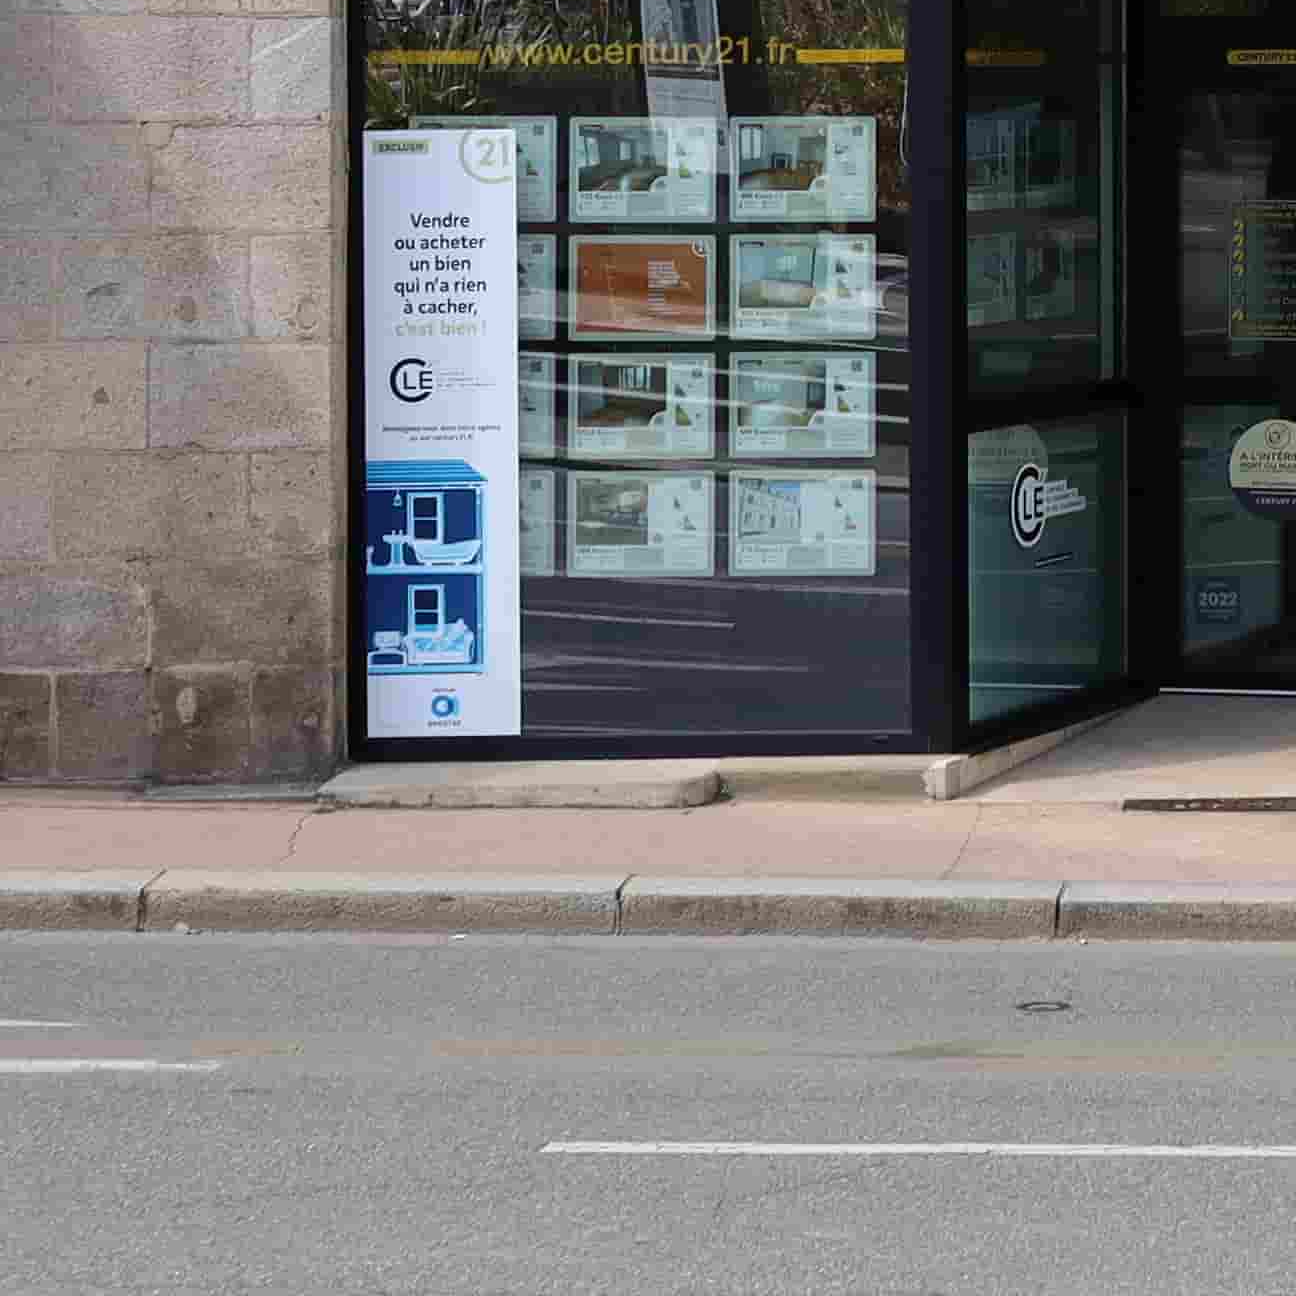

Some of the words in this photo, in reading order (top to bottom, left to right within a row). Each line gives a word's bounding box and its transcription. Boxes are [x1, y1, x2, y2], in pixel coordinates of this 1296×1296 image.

[479, 35, 799, 68] www.century21.fr
[410, 212, 471, 229] Vendre
[394, 236, 416, 251] ou
[420, 233, 486, 251] acheter
[409, 258, 430, 272] un
[435, 255, 471, 272] bien
[394, 276, 420, 297] qui
[425, 278, 449, 293] n'a
[454, 276, 487, 293] rien
[403, 298, 413, 315] à
[418, 299, 478, 317] cacher,
